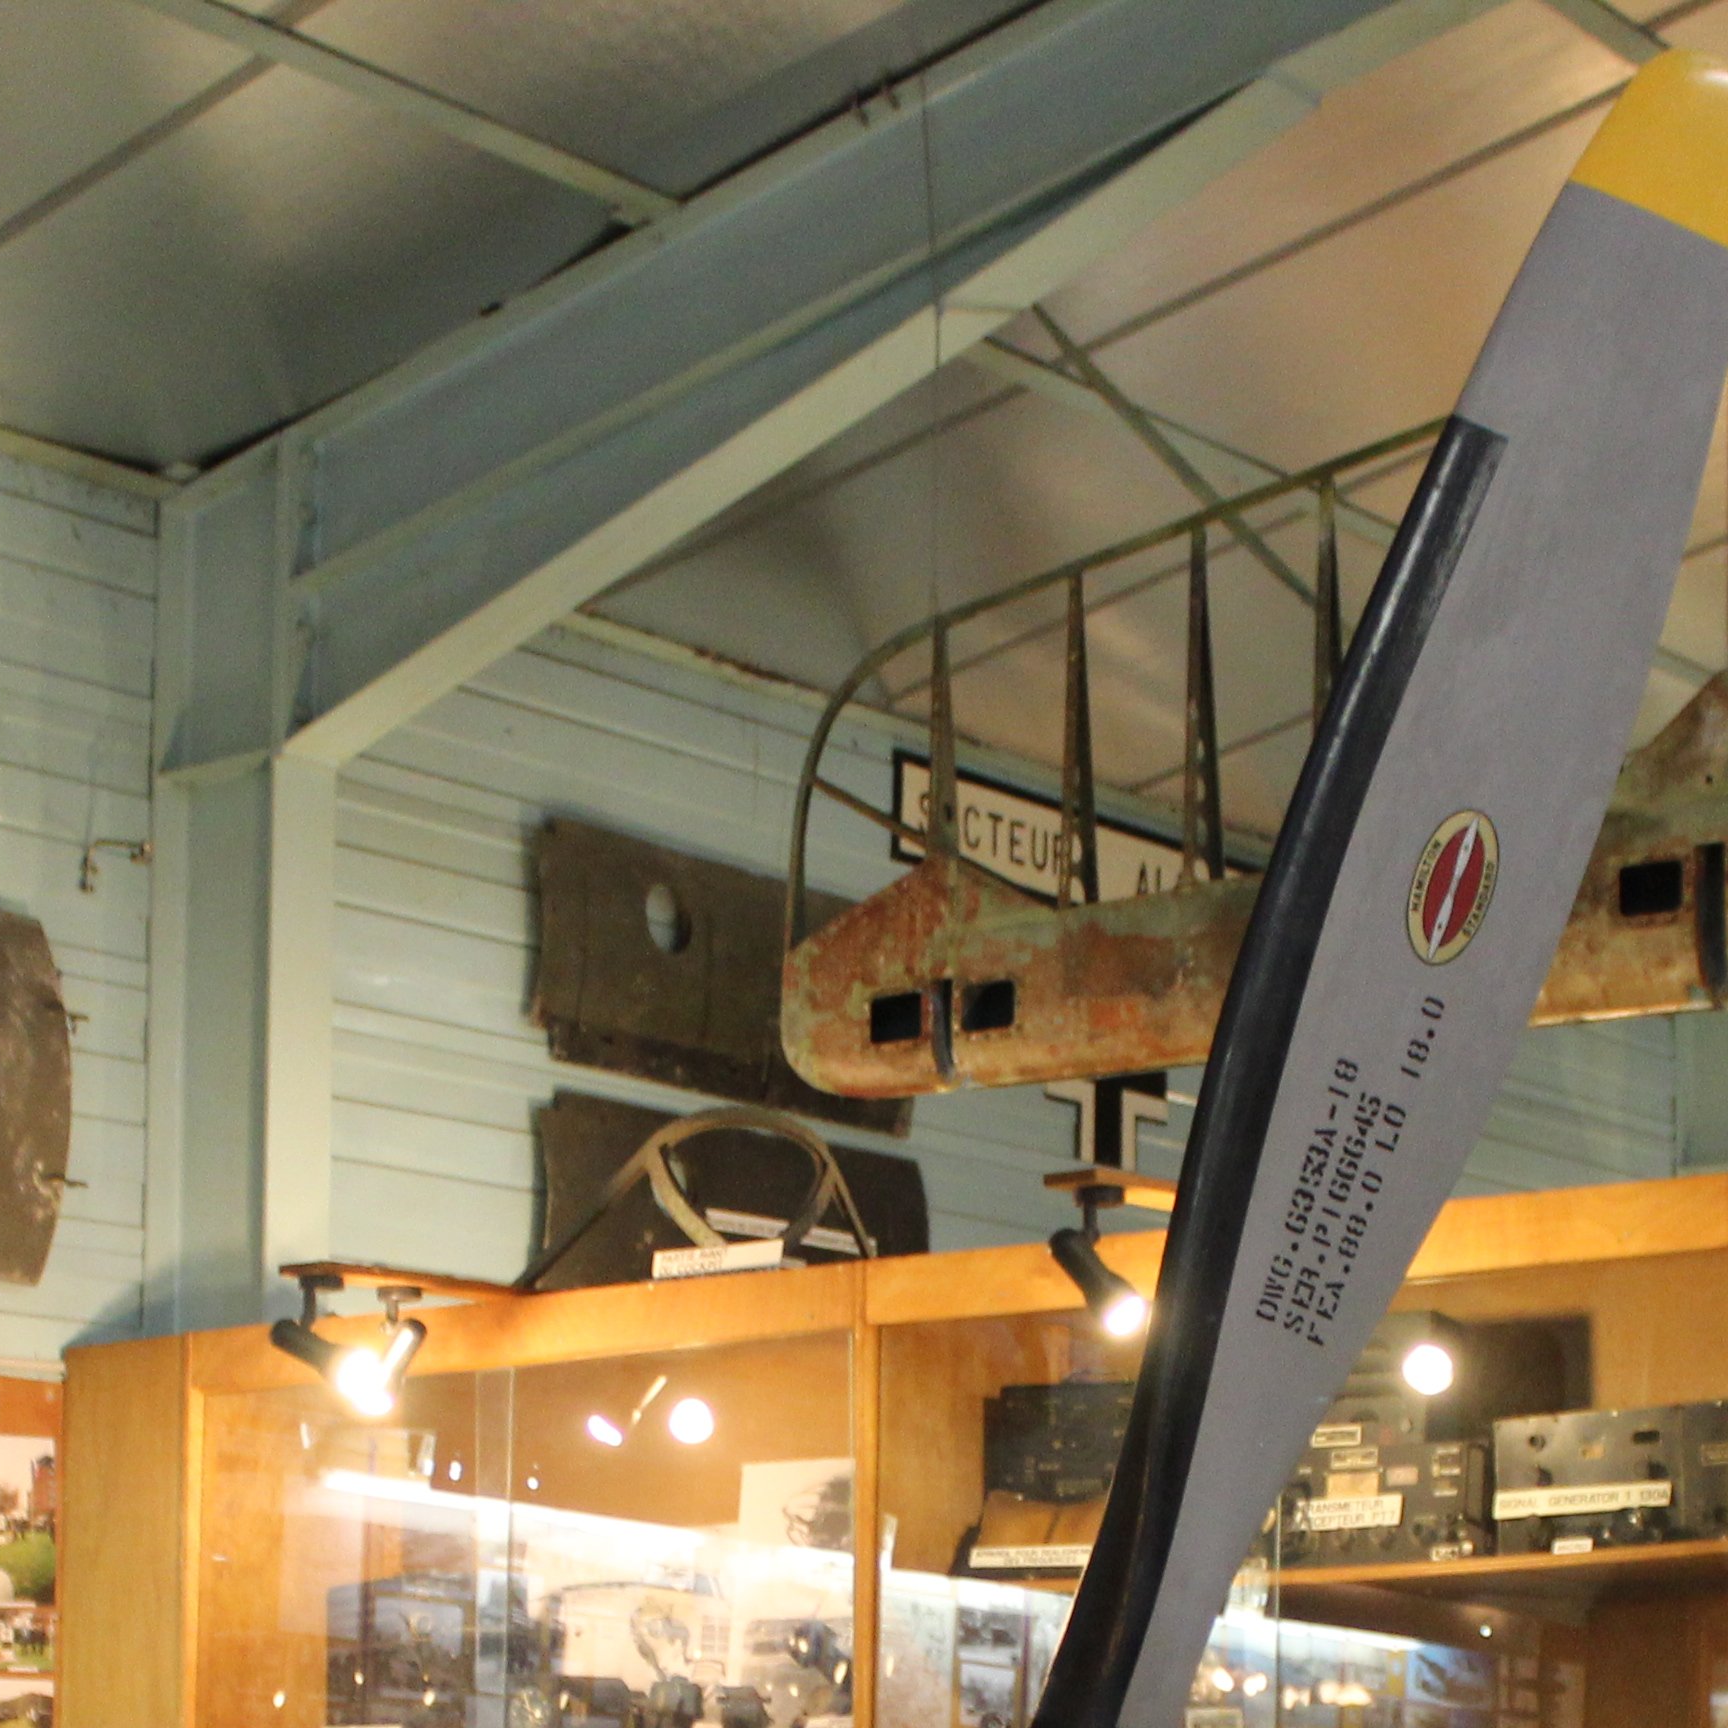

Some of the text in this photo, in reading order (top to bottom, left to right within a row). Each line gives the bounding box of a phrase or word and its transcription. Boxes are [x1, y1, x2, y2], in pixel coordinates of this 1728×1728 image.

[1409, 838, 1442, 913] HAMILTON
[1461, 860, 1496, 939] STANDARD
[1549, 1491, 1620, 1508] GENERATOR
